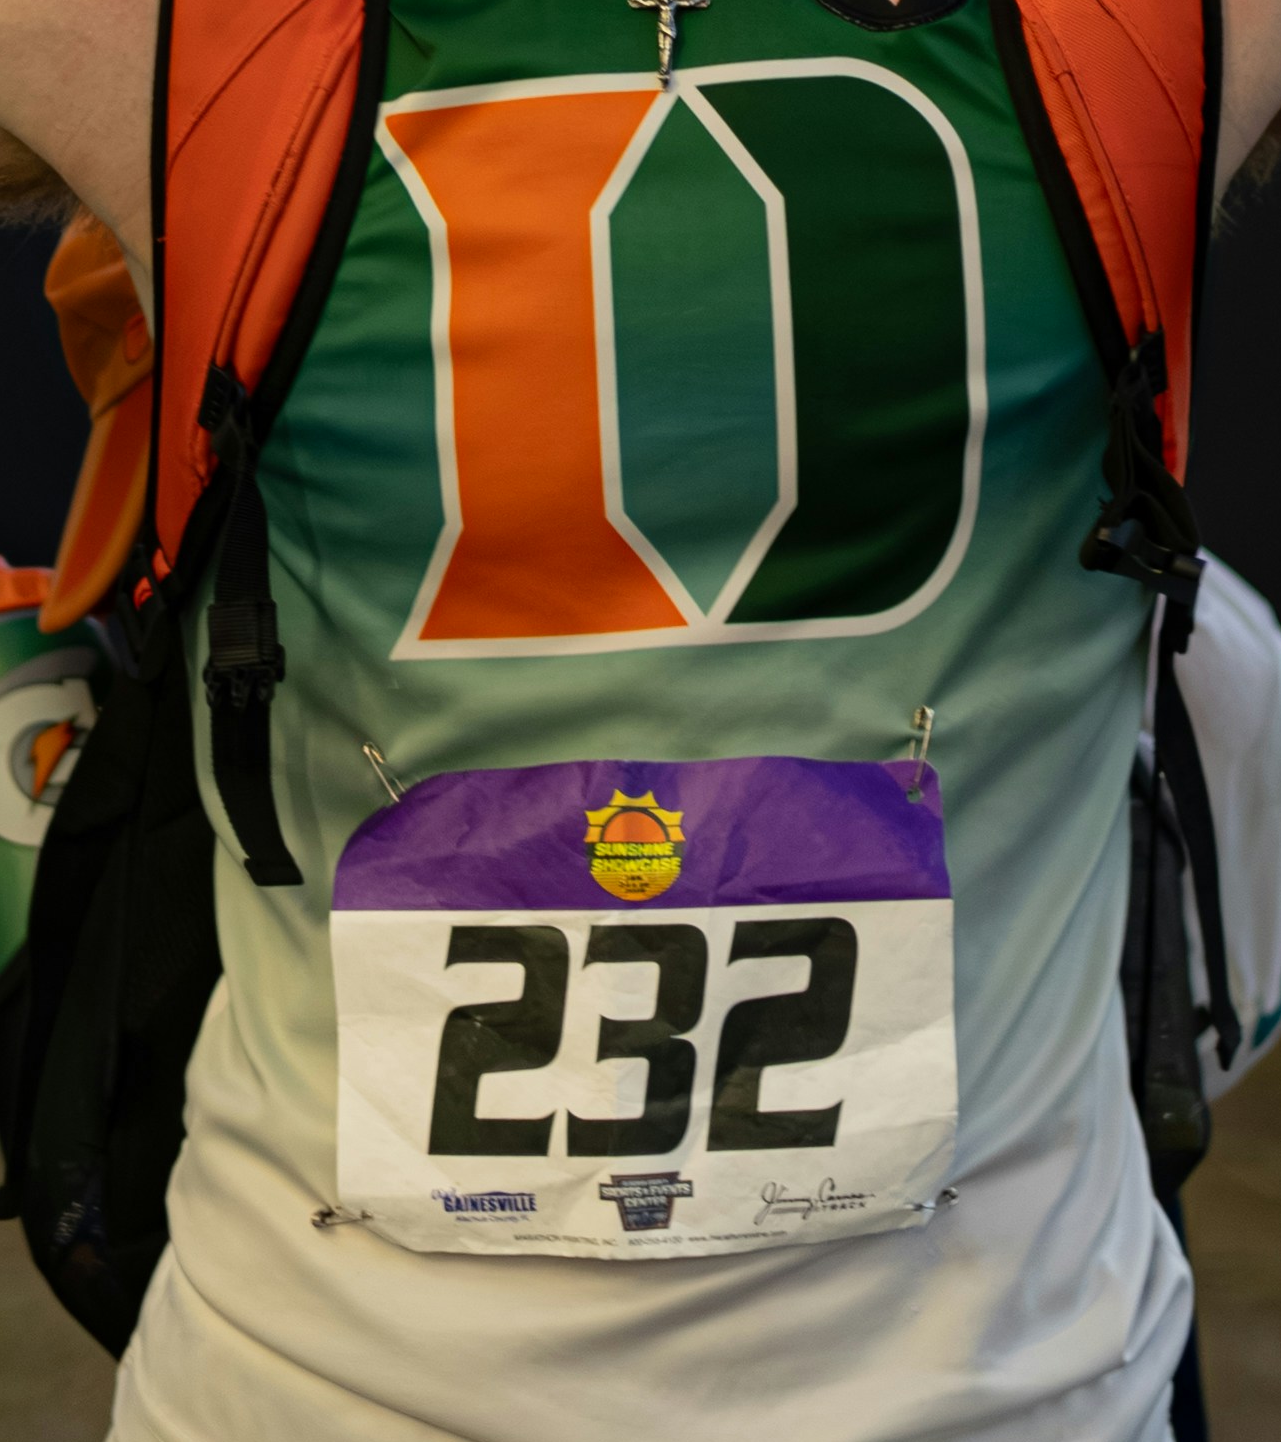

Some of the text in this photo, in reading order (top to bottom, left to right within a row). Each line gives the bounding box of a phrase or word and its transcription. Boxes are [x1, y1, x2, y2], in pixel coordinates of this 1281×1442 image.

[374, 56, 988, 660] D
[594, 841, 675, 857] SUNSHINE
[590, 856, 682, 873] SHOWCASE
[428, 916, 858, 1156] 232
[443, 1195, 537, 1213] GAINESVILLE
